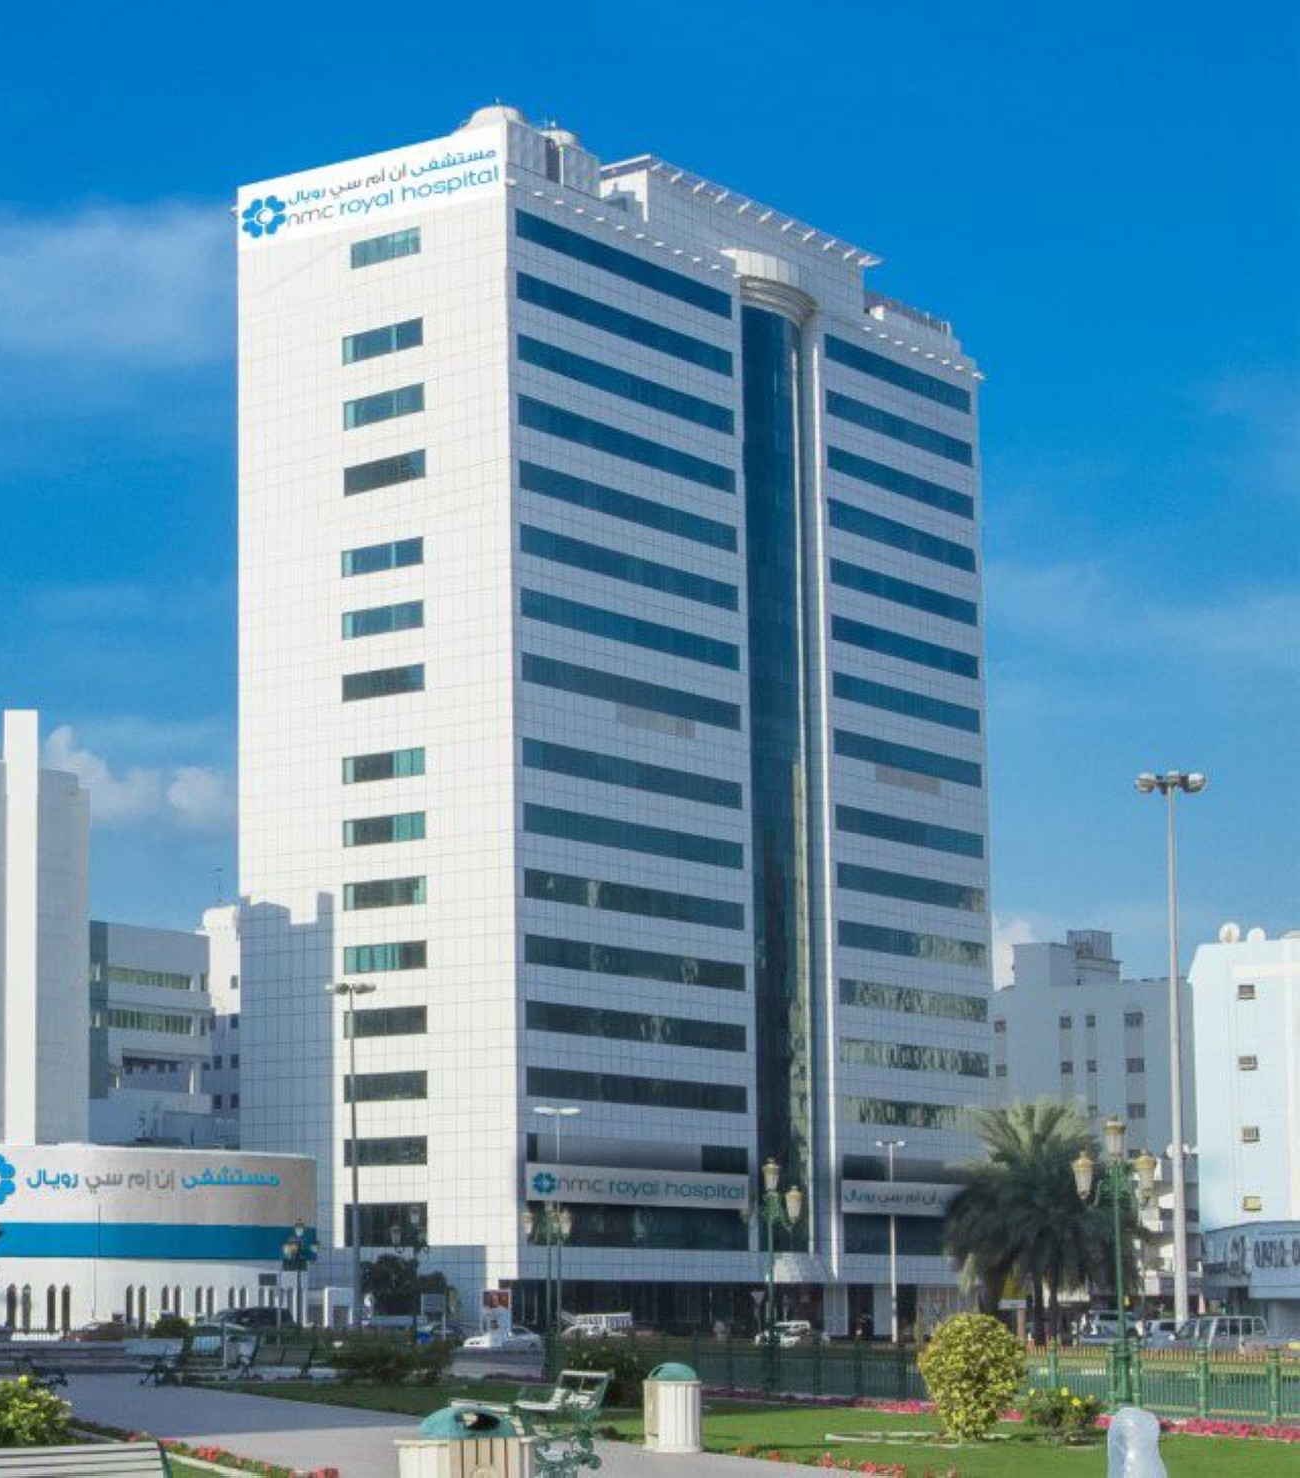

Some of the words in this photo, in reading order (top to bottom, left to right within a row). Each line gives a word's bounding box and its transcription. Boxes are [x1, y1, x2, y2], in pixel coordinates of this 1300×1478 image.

[286, 205, 334, 227] nmc
[340, 188, 394, 216] royal
[401, 164, 499, 202] hospital
[26, 1168, 79, 1191] رويال
[85, 1171, 123, 1194] سي
[181, 1165, 281, 1189] مستشفى
[558, 1176, 605, 1194] nmc
[608, 1178, 661, 1197] royal
[664, 1181, 746, 1200] hospital
